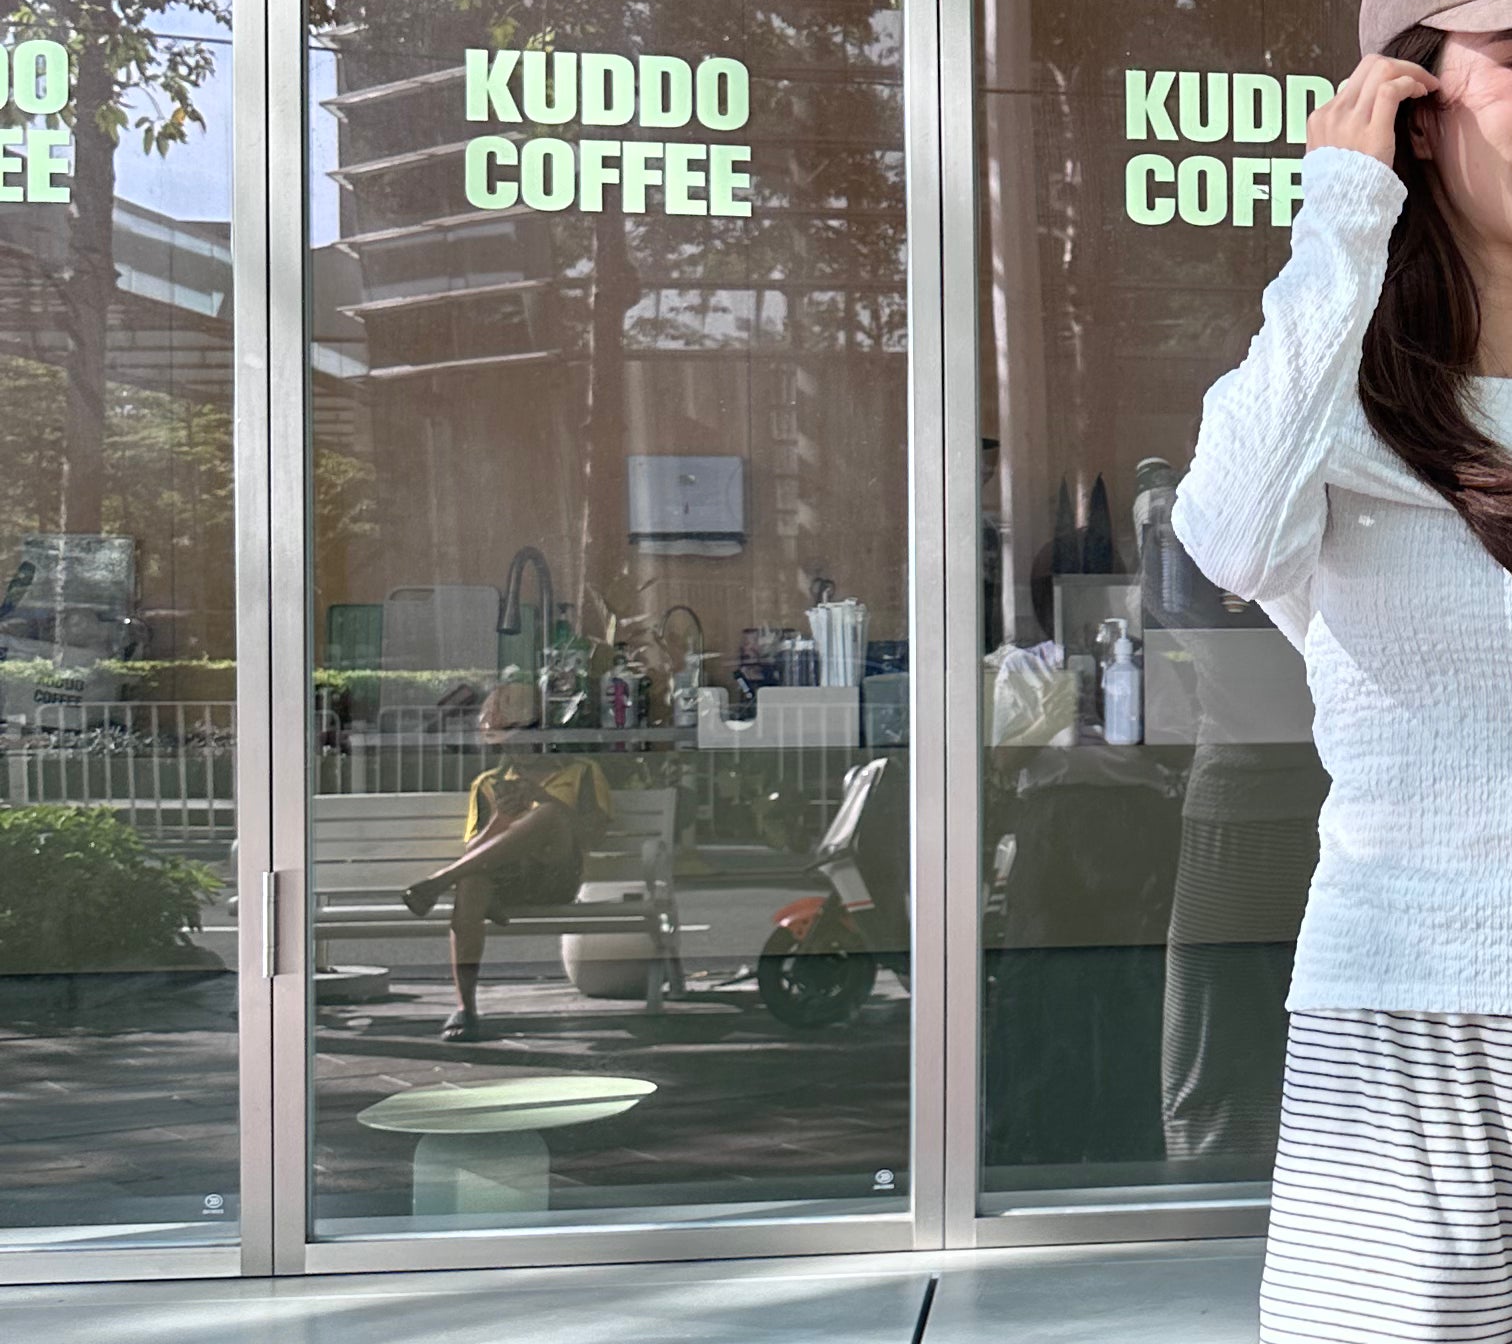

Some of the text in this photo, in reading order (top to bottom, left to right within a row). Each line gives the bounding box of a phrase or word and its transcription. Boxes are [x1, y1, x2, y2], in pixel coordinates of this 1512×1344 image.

[0, 40, 69, 114] O
[465, 49, 750, 131] KUDDO
[1126, 70, 1349, 144] KUDD
[465, 136, 752, 217] COFFEE
